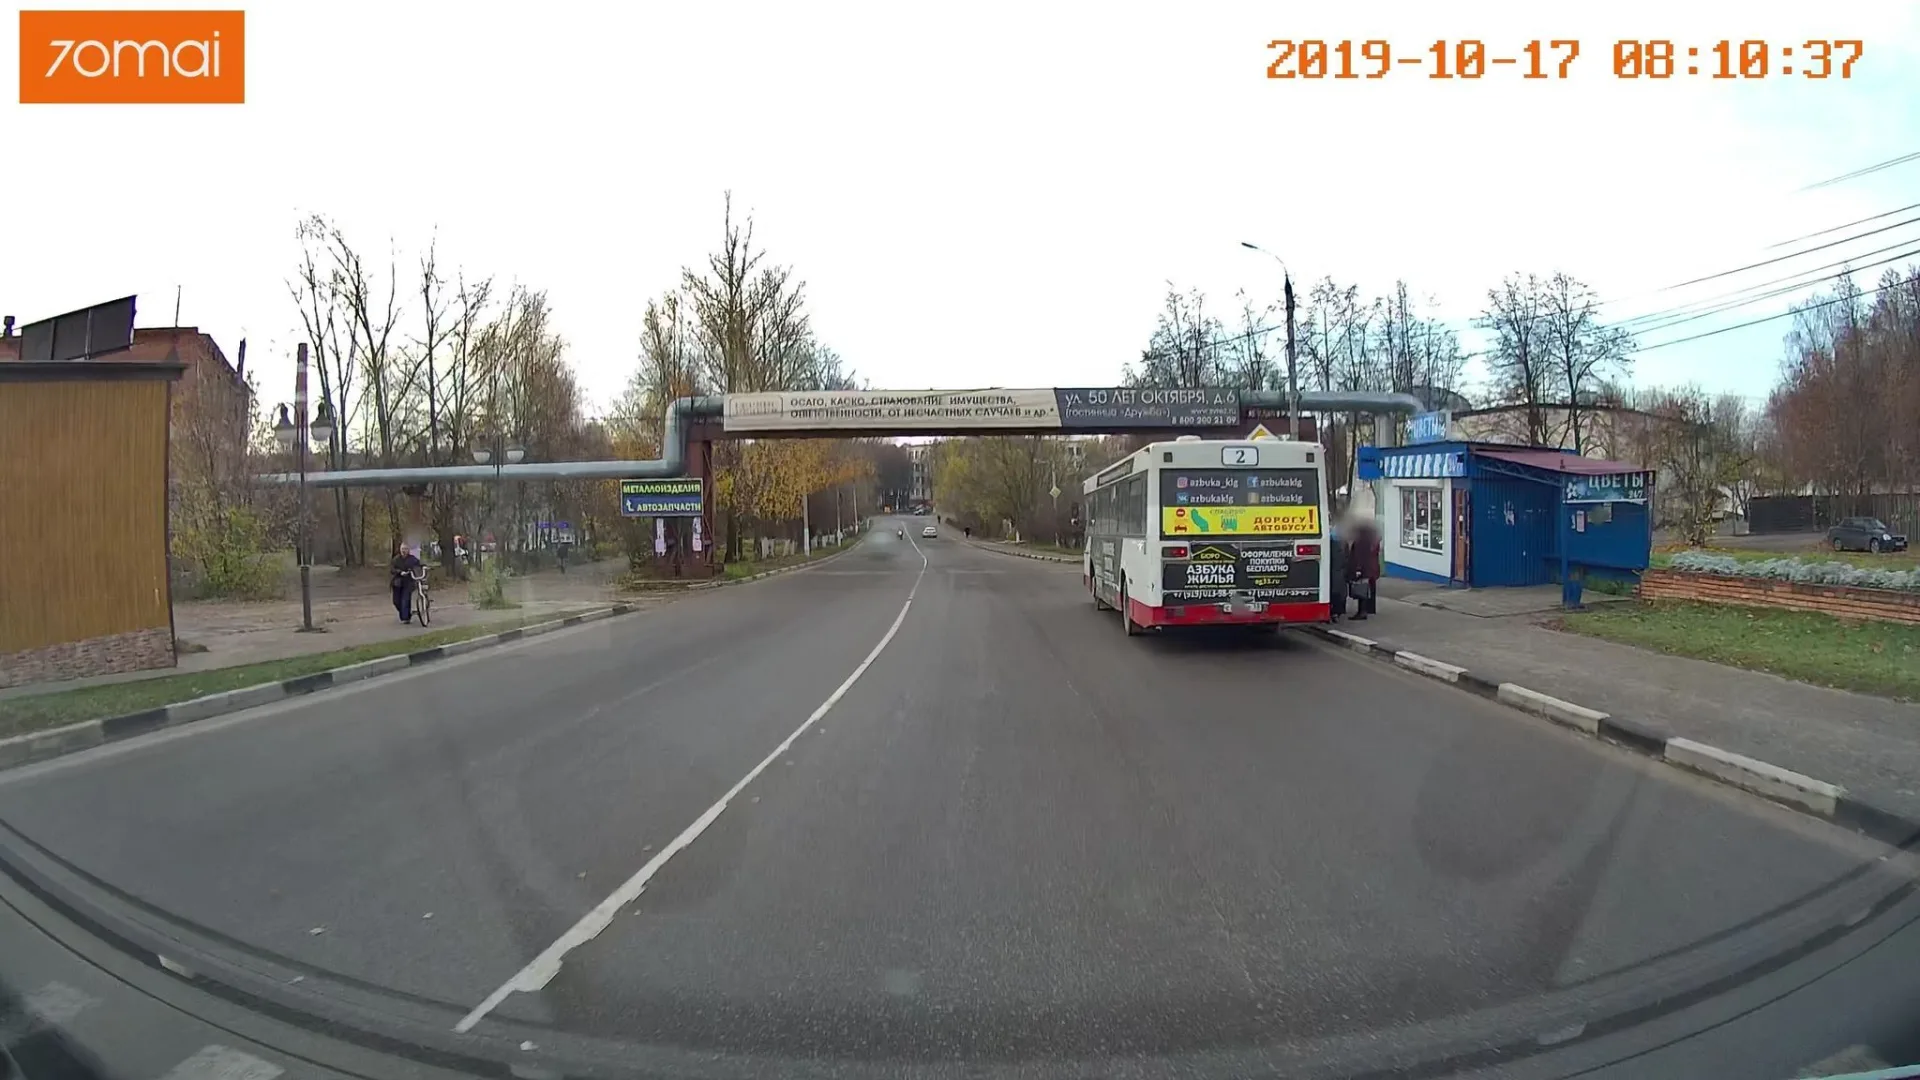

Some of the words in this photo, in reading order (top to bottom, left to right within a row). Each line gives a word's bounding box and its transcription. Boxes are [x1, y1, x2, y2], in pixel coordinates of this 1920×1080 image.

[790, 397, 828, 407] ОСАГО,
[830, 396, 869, 407] КАСКО,
[949, 395, 1017, 406] ИМУЩЕСТВА,
[1088, 389, 1108, 405] 50
[1112, 389, 1137, 405] ЛЕТ
[1141, 389, 1209, 406] ОКТЯБРЯ,
[888, 408, 901, 418] ОТ
[904, 407, 972, 418] НЕСЧАСТНЫХ
[975, 406, 1021, 417] СЛУЧАЕВ
[1235, 449, 1246, 464] 2
[1588, 472, 1644, 491] ЦВЕТЫ
[623, 484, 701, 494] МЕТАЛЛОИЗДЕЛИЯ
[636, 502, 701, 512] АВТОЗАПЧАСТИ
[1253, 516, 1306, 525] ДОРОГУ
[1253, 524, 1307, 532] АВТОБУСУ
[1240, 550, 1293, 559] ОФОРМЛЕНИЕ
[1249, 558, 1286, 566] ПОКУПКИ
[1186, 564, 1236, 575] АЗБУКА
[1246, 565, 1289, 573] БЕСПЛАТНО
[1187, 574, 1235, 584] ЖИЛЬЯ
